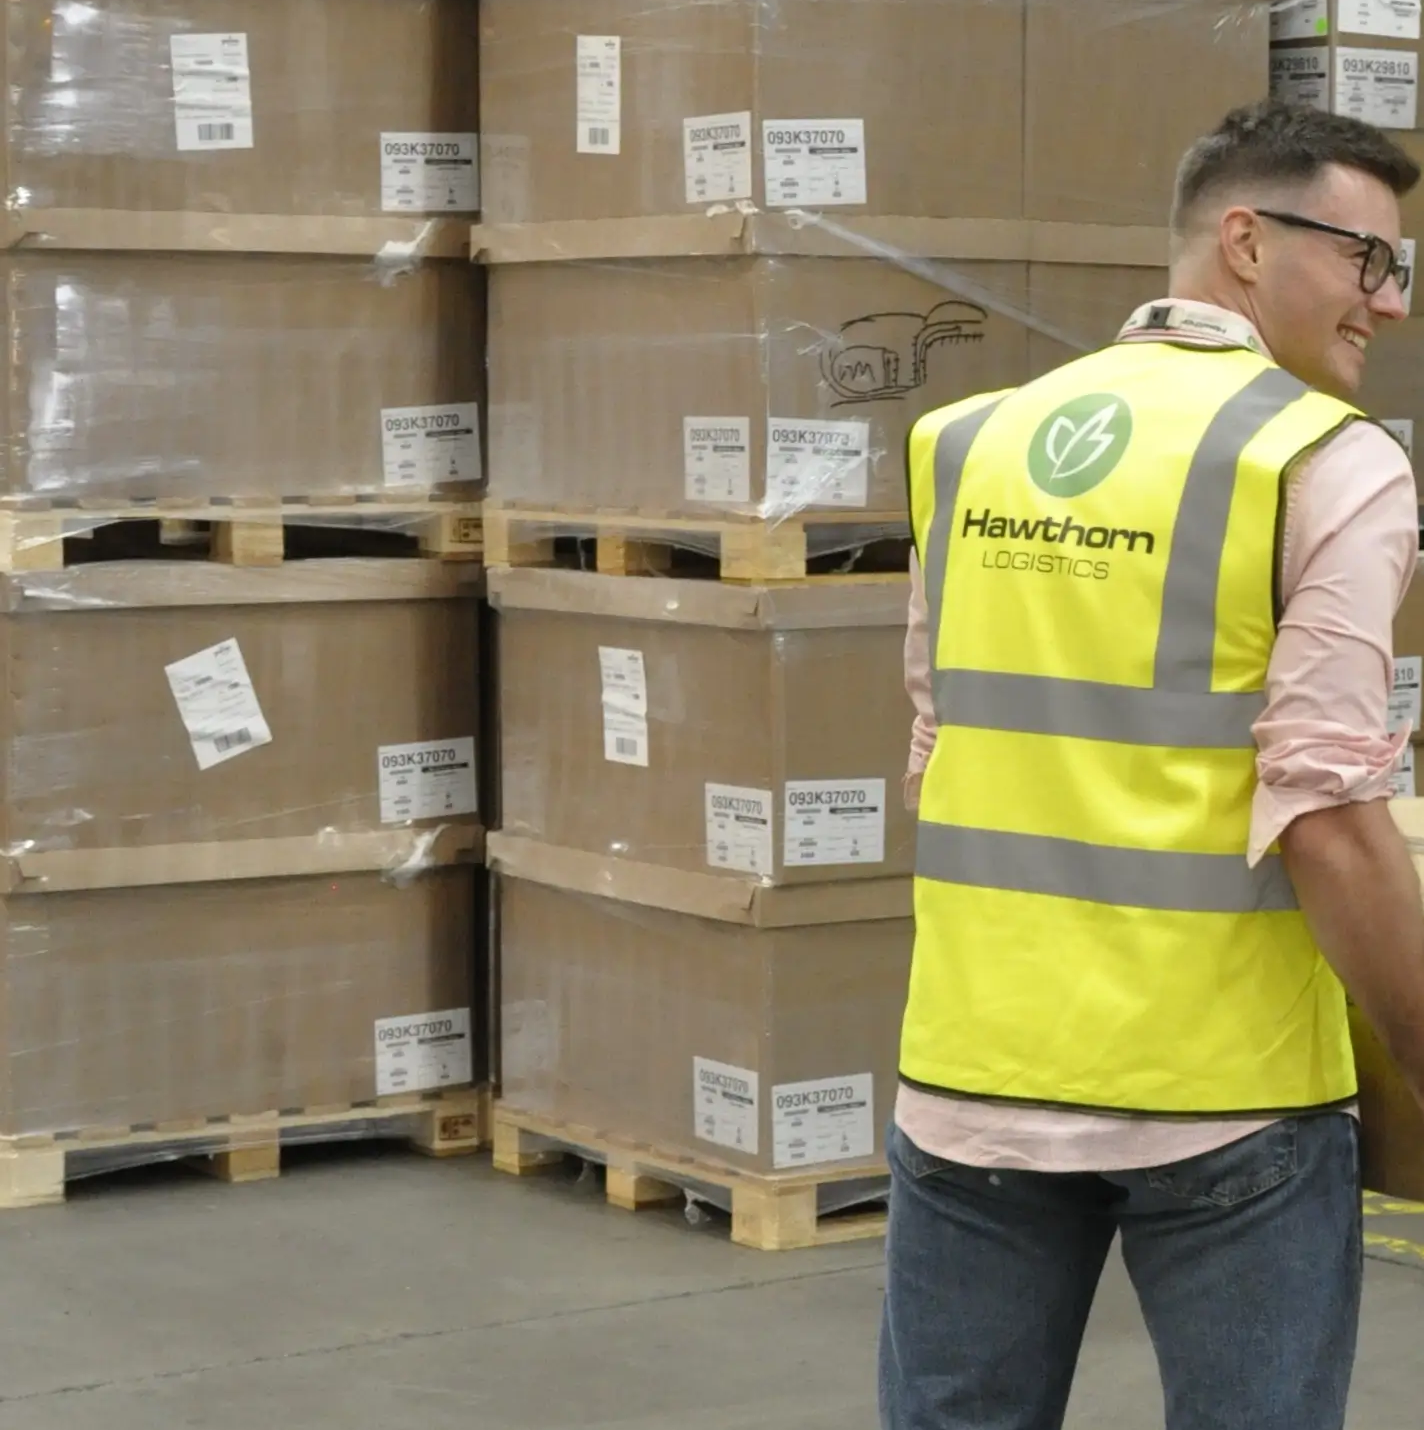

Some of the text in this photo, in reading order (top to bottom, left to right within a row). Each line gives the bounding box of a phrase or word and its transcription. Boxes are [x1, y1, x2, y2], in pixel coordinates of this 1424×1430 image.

[1343, 58, 1410, 74] 093K29810
[768, 130, 845, 144] 093K37070
[384, 142, 459, 158] 093K37070
[385, 413, 460, 433] 093K37070
[962, 508, 1155, 555] Hawthorn
[981, 550, 1110, 580] LOGISTICS
[382, 748, 456, 769] 093K37070
[788, 790, 866, 806] 093K37070
[378, 1019, 452, 1042] 093K37070
[776, 1088, 854, 1108] 093K37070
